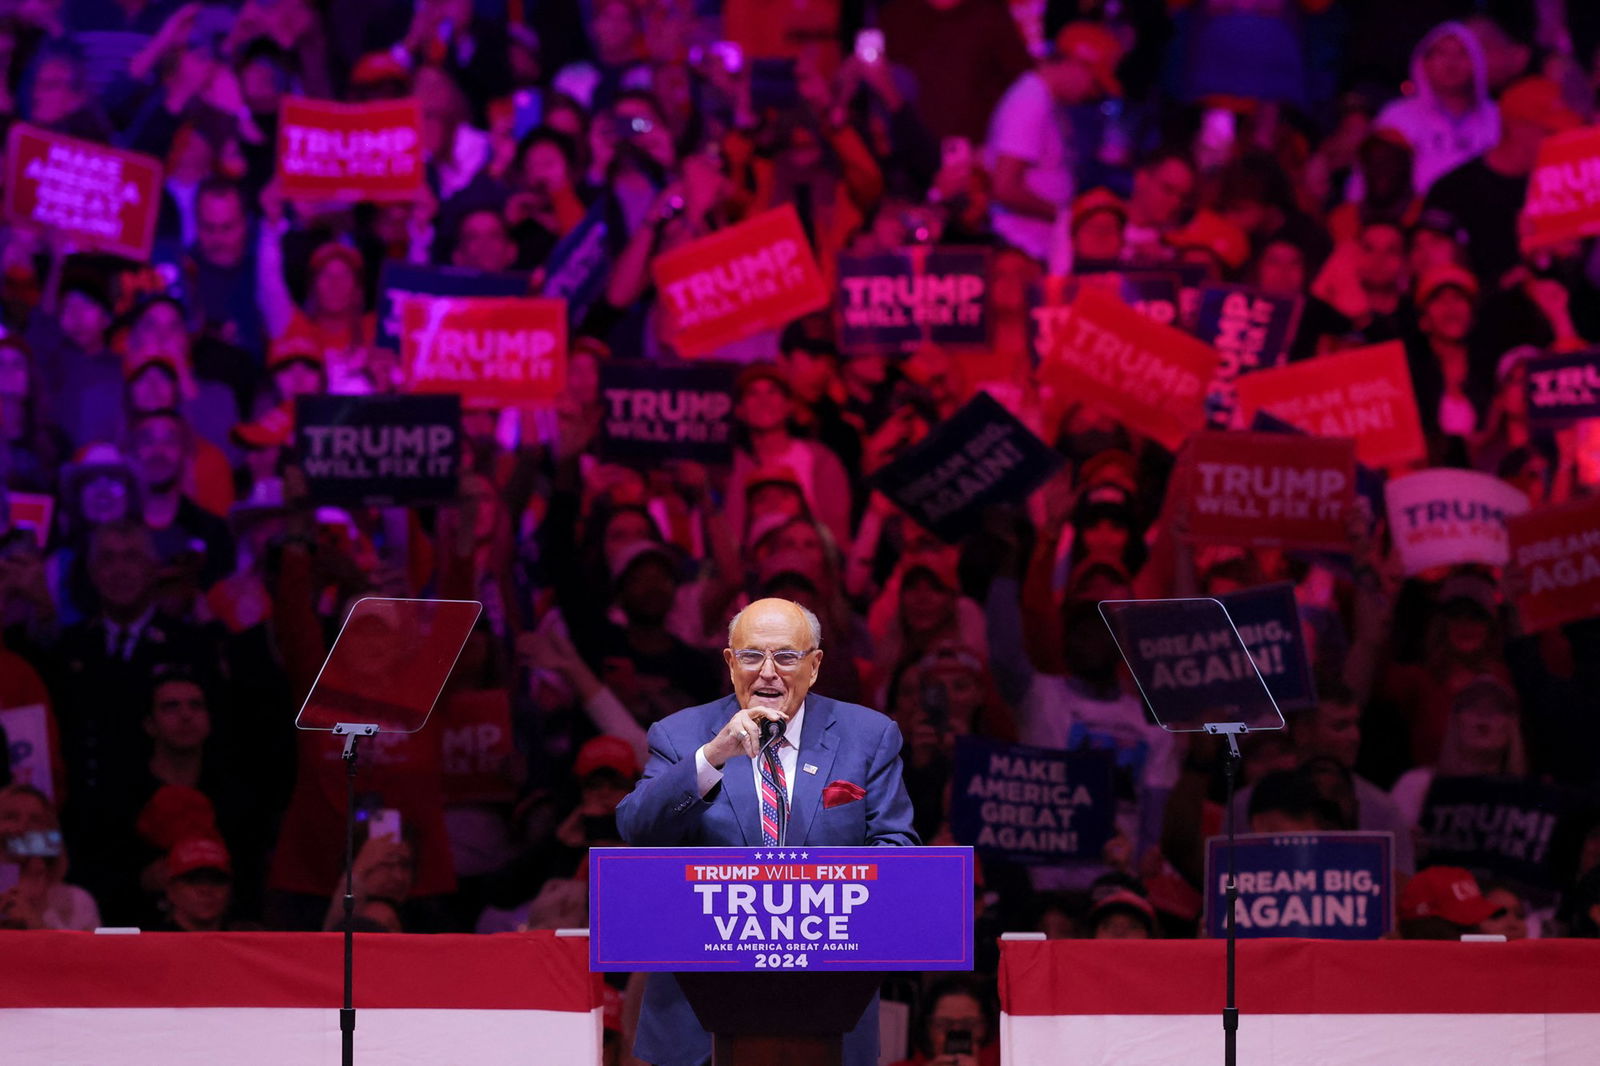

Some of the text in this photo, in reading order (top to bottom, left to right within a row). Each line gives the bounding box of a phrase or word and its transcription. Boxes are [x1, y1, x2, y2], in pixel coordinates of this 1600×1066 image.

[286, 127, 417, 158] TRUMP
[667, 240, 798, 309] TRUMP
[843, 274, 985, 306] TRUMP
[410, 330, 555, 360] TRUMP
[1075, 317, 1200, 397] TRUMP
[606, 389, 732, 420] TRUMP
[303, 425, 455, 456] TRUMP
[305, 456, 453, 478] WILL FIX IT
[1198, 463, 1346, 499] TRUMP
[1196, 496, 1342, 520] WILL FIX IT
[1404, 500, 1505, 527] TRUM
[1138, 620, 1292, 659] DREAM BIG,
[1153, 645, 1286, 689] AGAIN!
[989, 755, 1068, 783] MAKE
[966, 773, 1093, 806] AMERICA
[981, 801, 1075, 830] GREAT
[977, 825, 1079, 852] AGAIN!
[694, 865, 869, 879] TRUMP WILL FIX IT
[1219, 870, 1380, 896] DREAM BIG,
[694, 884, 869, 914] TRUMP
[1222, 895, 1368, 928] AGAIN!
[713, 916, 849, 940] VANCE
[755, 953, 808, 968] 2024
